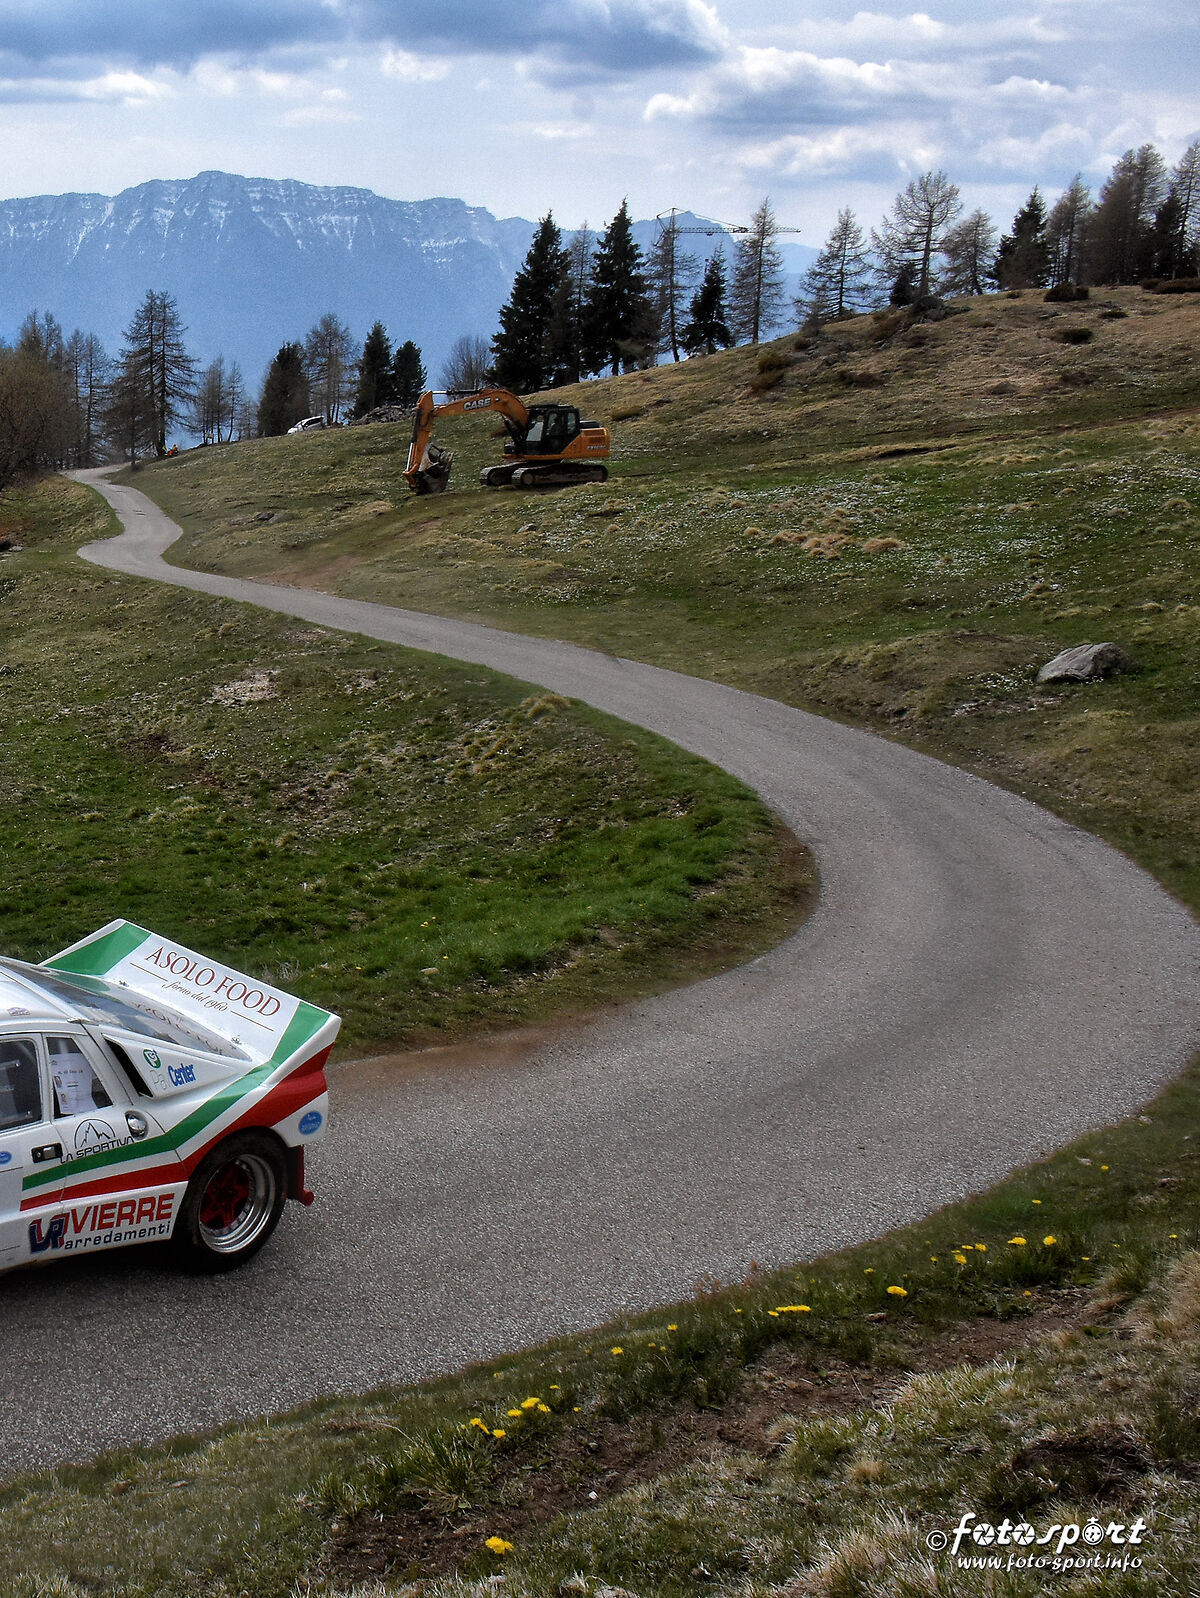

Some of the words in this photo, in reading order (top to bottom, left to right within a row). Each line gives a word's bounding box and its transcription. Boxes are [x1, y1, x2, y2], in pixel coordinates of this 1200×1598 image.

[464, 398, 492, 410] CASE
[144, 947, 216, 987] ASOLO
[213, 975, 281, 1016] FOOD
[168, 1063, 197, 1087] Center
[60, 1153, 74, 1164] LA
[76, 1136, 135, 1159] SPORTIVA
[71, 1193, 175, 1234] VIERRE
[64, 1221, 171, 1250] arredamenti
